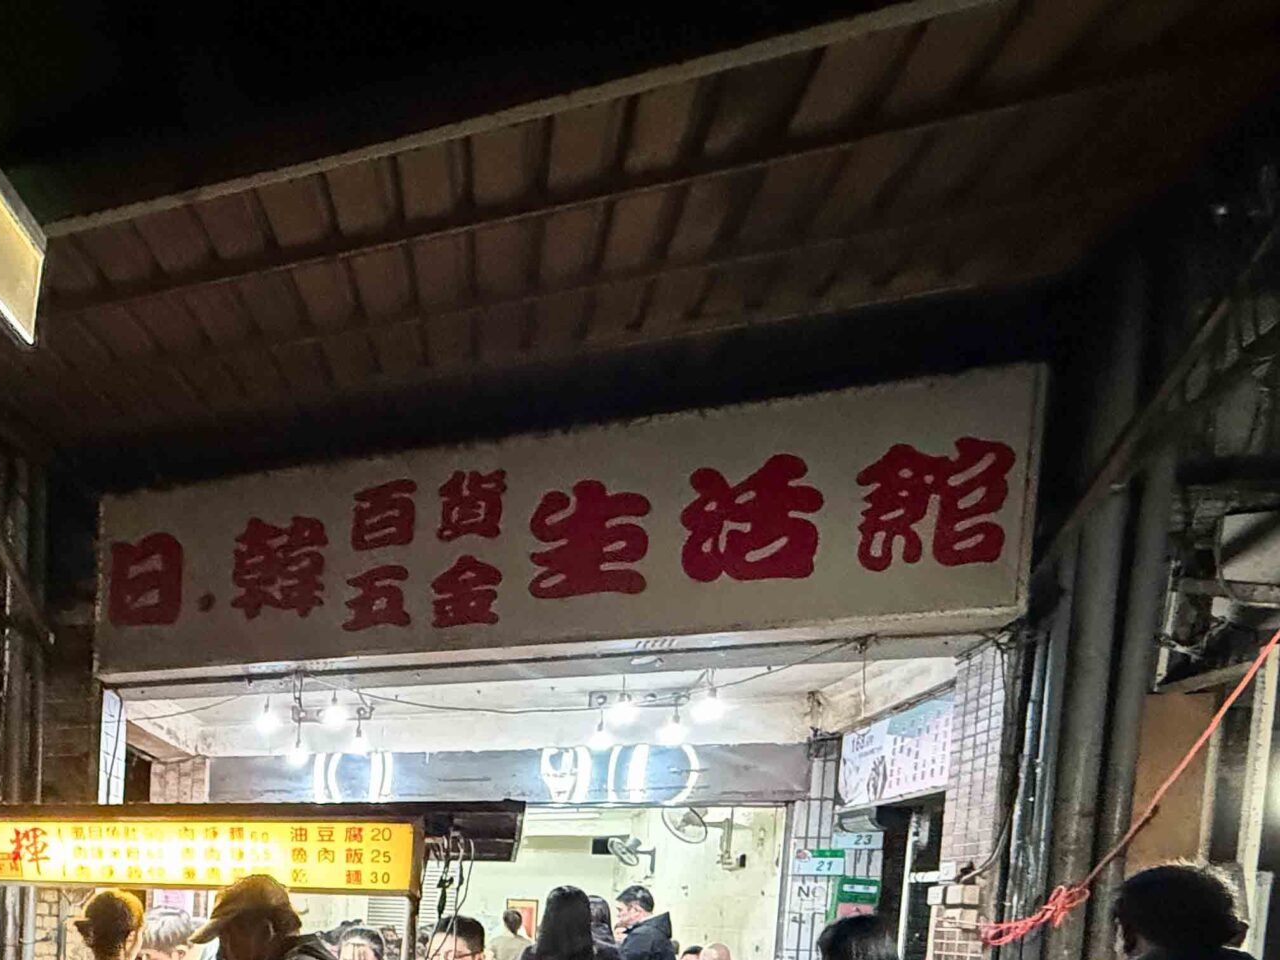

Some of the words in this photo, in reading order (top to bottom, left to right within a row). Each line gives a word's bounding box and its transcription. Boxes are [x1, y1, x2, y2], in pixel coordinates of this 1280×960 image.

[352, 468, 507, 551] 百貨
[528, 435, 1017, 600] 生活館
[342, 553, 504, 632] 五金
[290, 826, 364, 844] 油豆腐
[370, 827, 392, 842] 20
[854, 834, 873, 846] 23
[370, 849, 391, 864] 25
[816, 860, 833, 872] 21
[370, 871, 391, 885] 30
